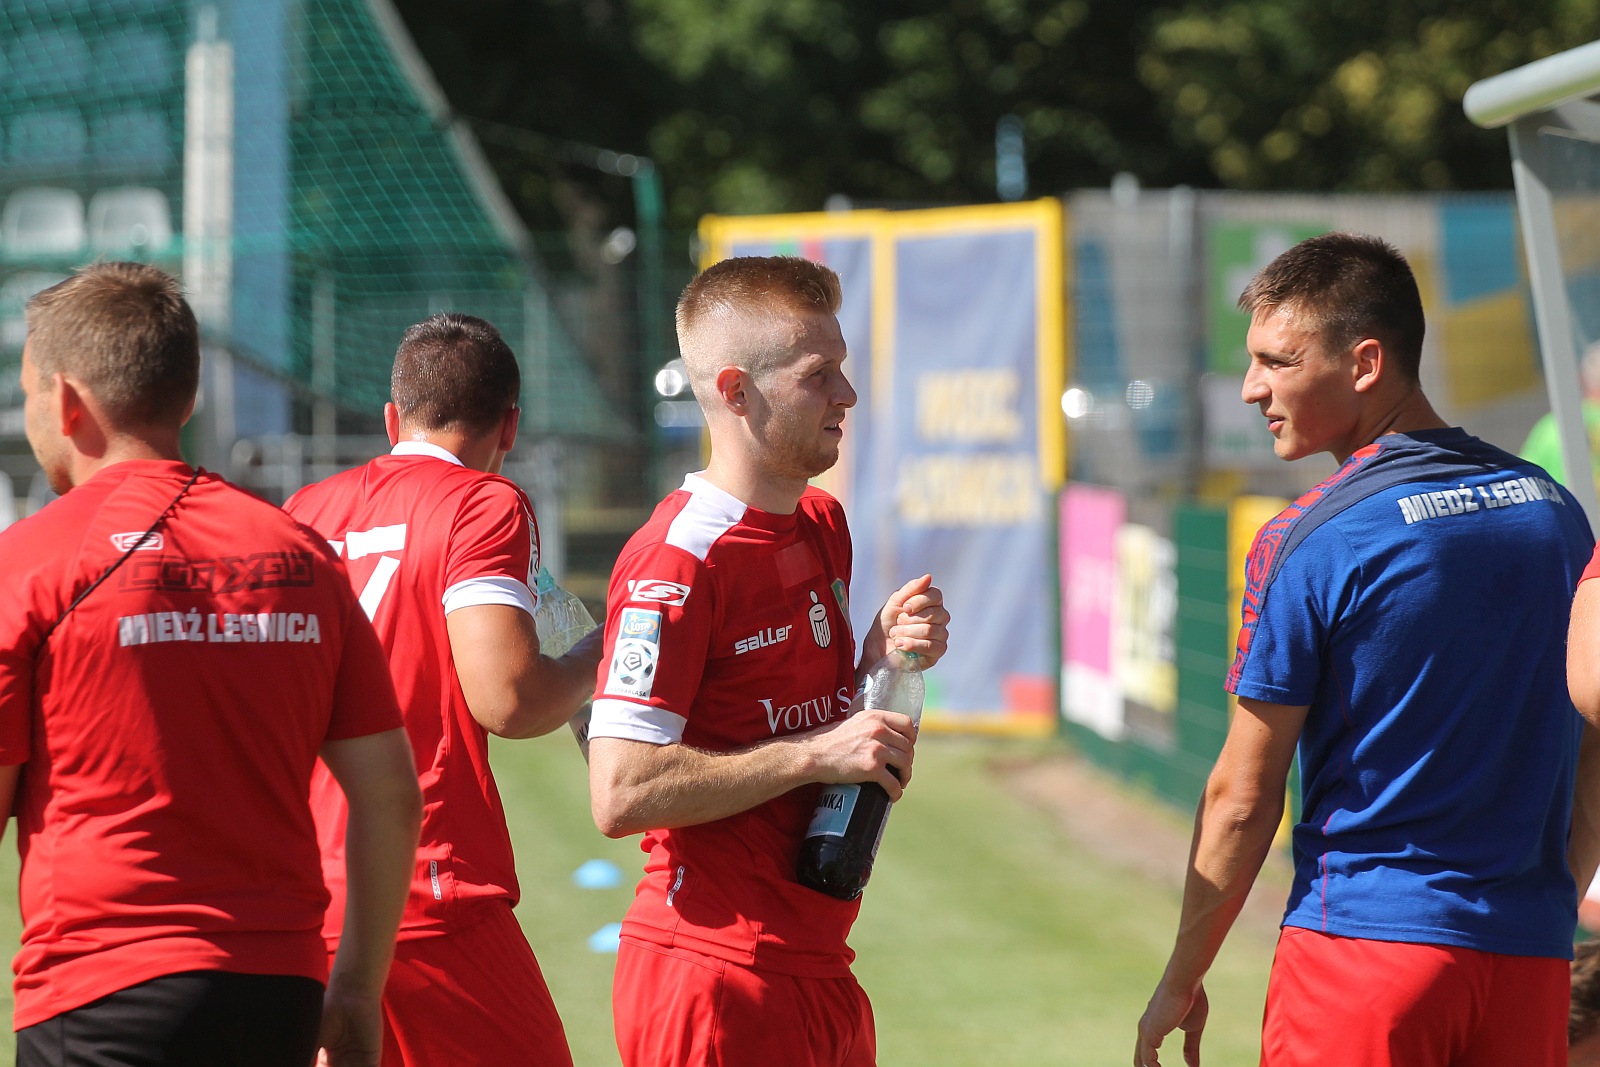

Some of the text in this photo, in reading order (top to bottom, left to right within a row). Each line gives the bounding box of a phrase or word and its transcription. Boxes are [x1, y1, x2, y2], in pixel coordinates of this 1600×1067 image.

[1476, 476, 1566, 509] LEGNICA
[327, 523, 407, 623] 7
[207, 612, 321, 644] LEGNICA
[734, 624, 793, 656] saller
